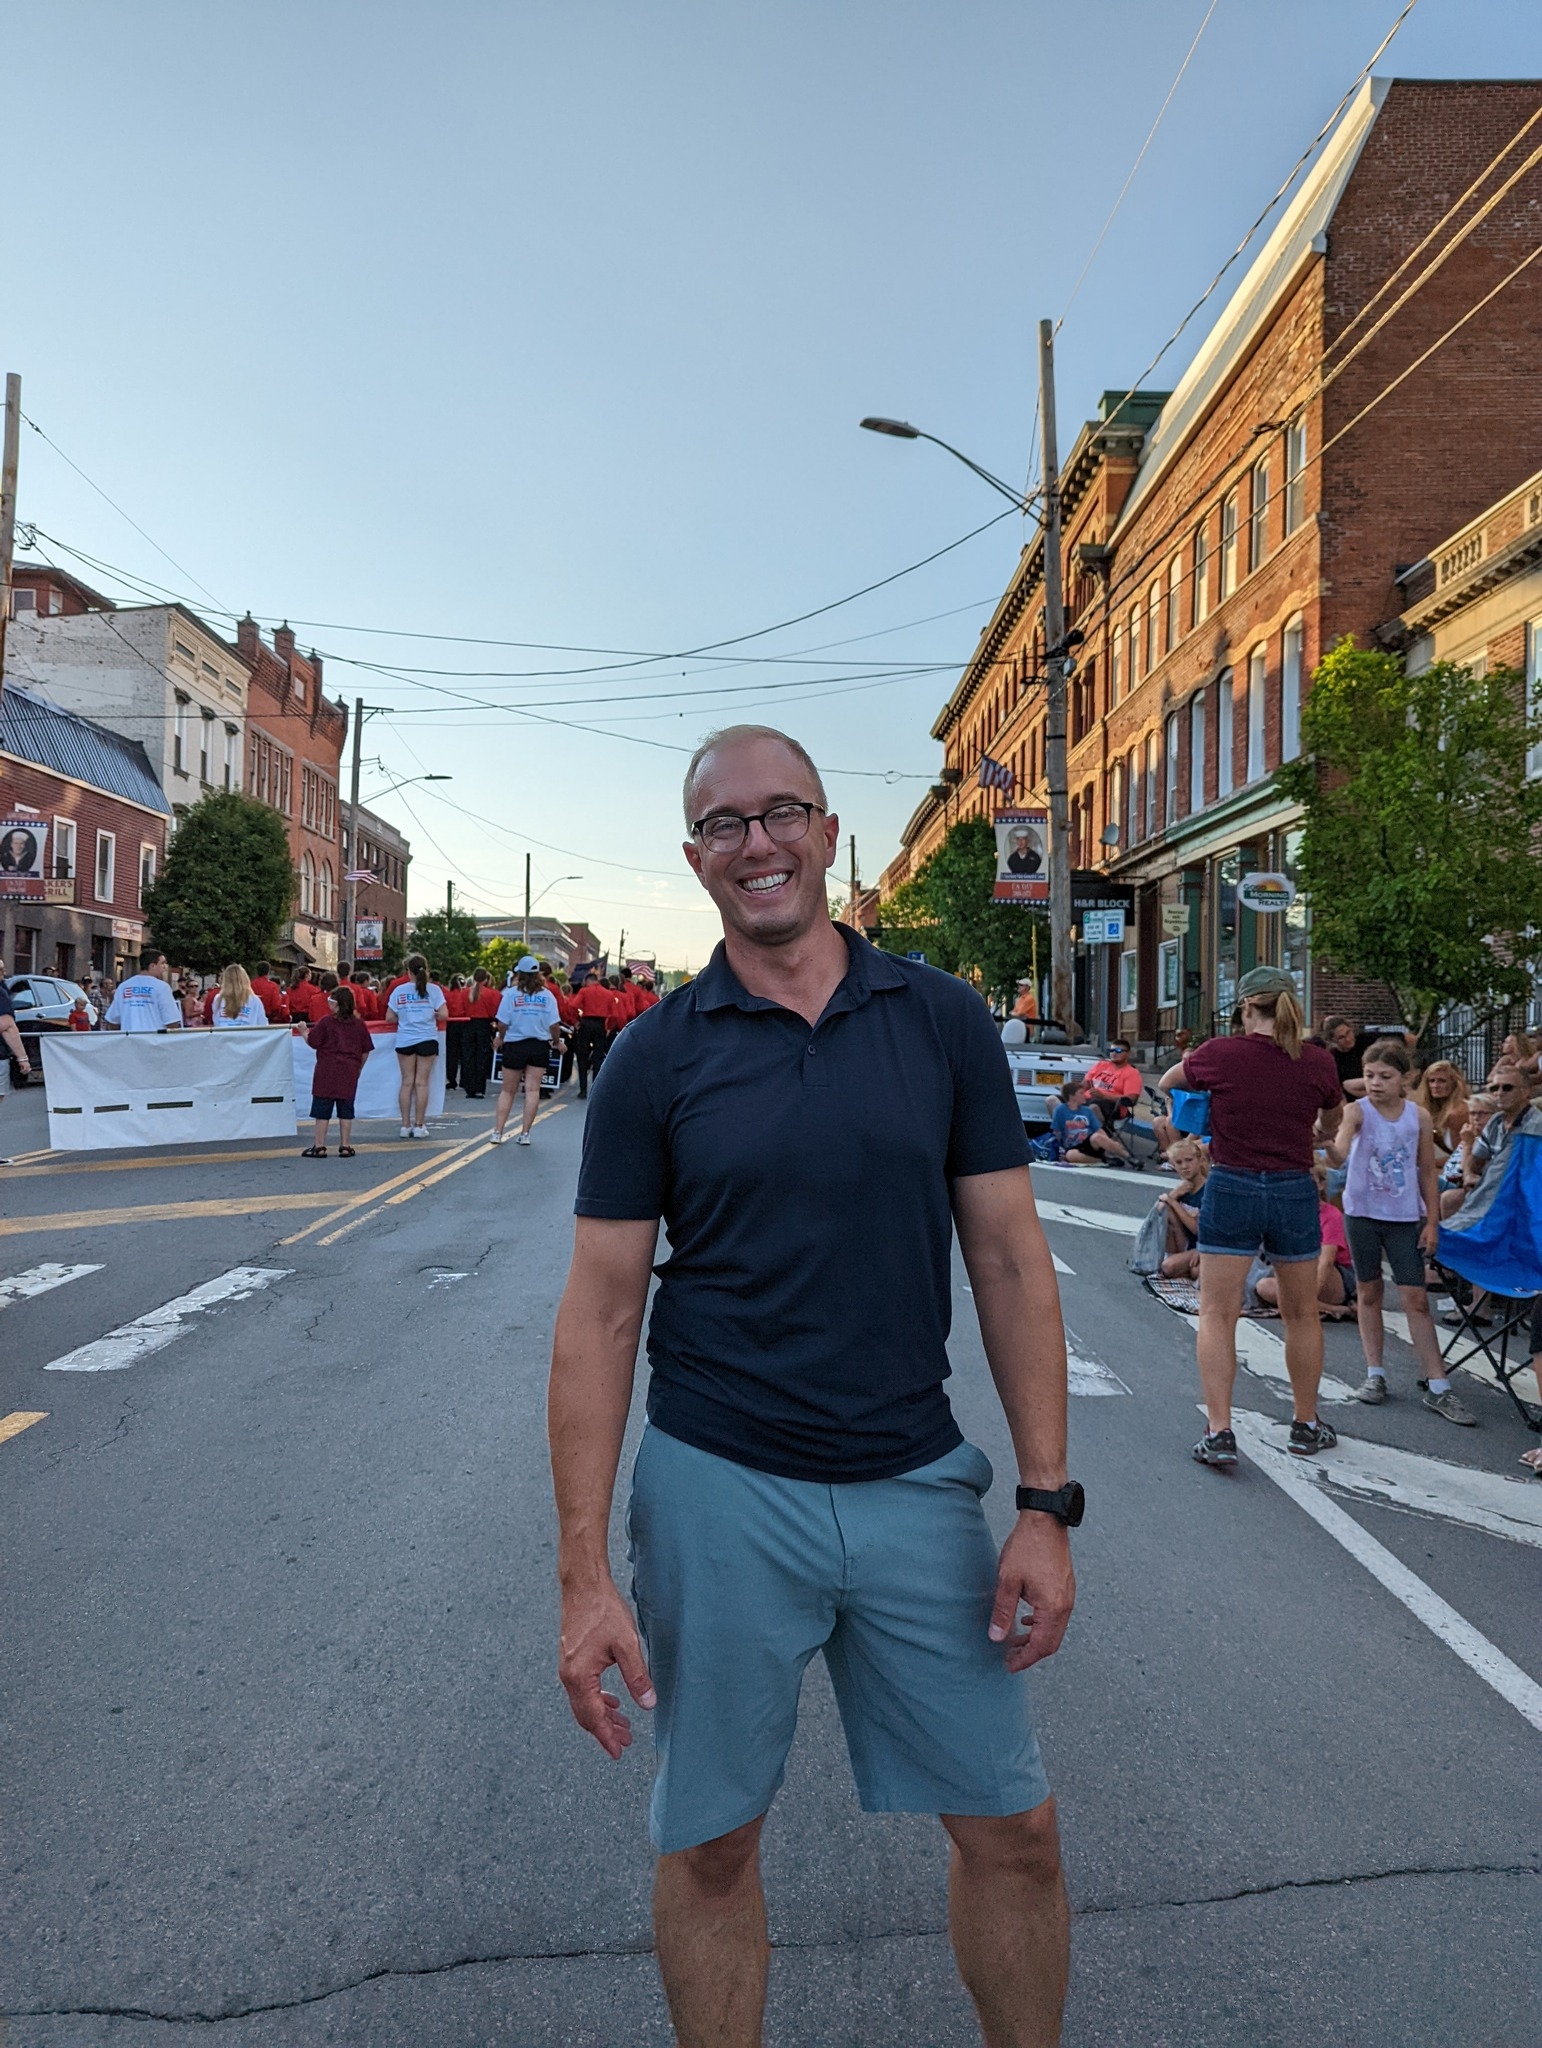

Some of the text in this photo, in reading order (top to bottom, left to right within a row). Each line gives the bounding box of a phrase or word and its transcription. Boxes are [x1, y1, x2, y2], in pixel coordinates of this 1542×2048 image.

[1074, 899, 1130, 908] H&R BLOCK
[524, 995, 547, 1004] ELISE
